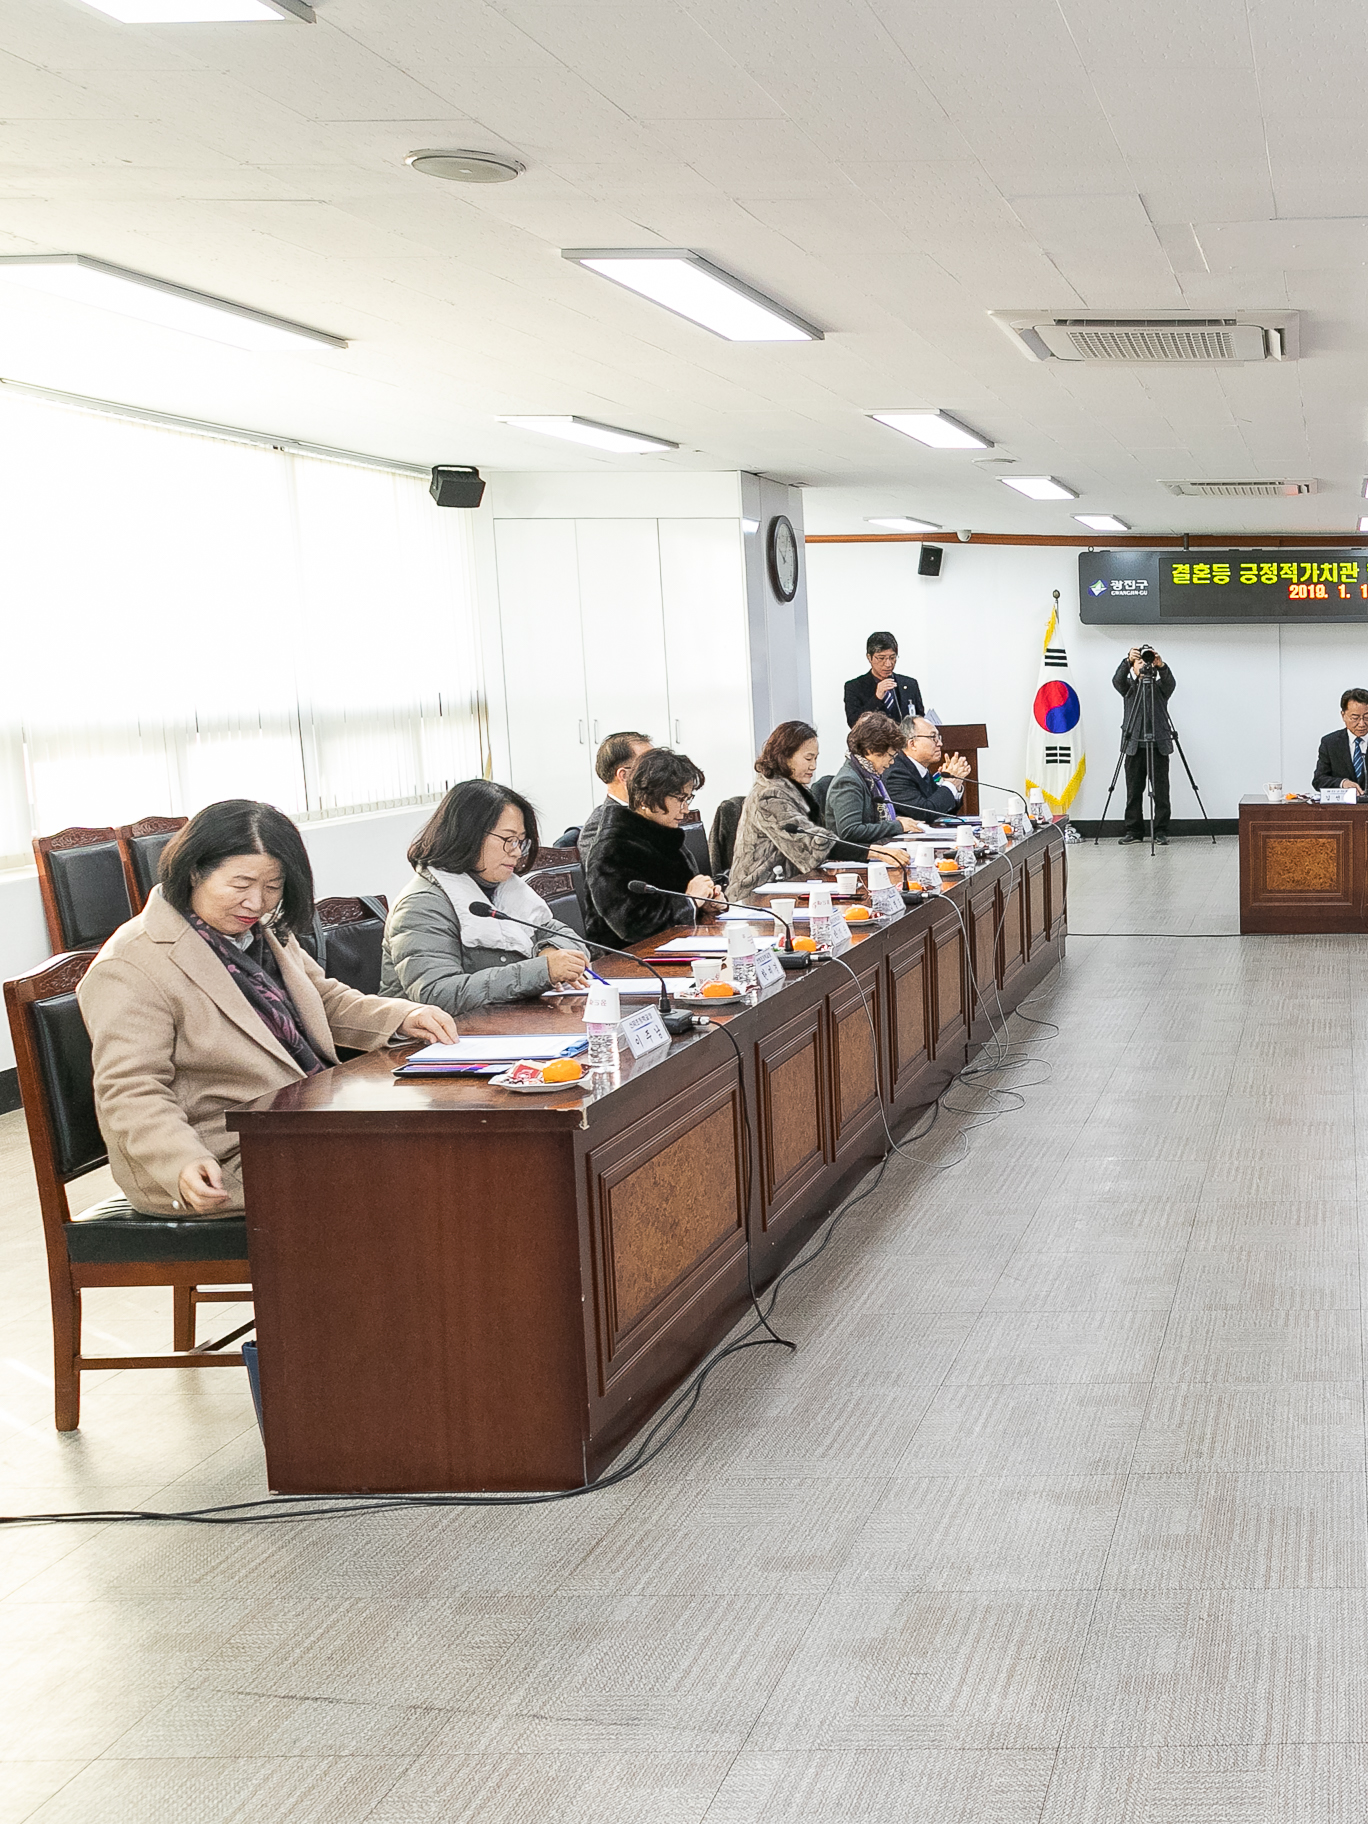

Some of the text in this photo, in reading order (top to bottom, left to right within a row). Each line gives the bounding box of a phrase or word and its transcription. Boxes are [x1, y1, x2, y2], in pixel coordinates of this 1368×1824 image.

[1171, 563, 1230, 584] 결혼등
[1239, 562, 1359, 584] 긍정적가치관
[1110, 579, 1149, 590] 광진구
[1288, 584, 1328, 599] 2019.
[1337, 584, 1351, 598] 1.
